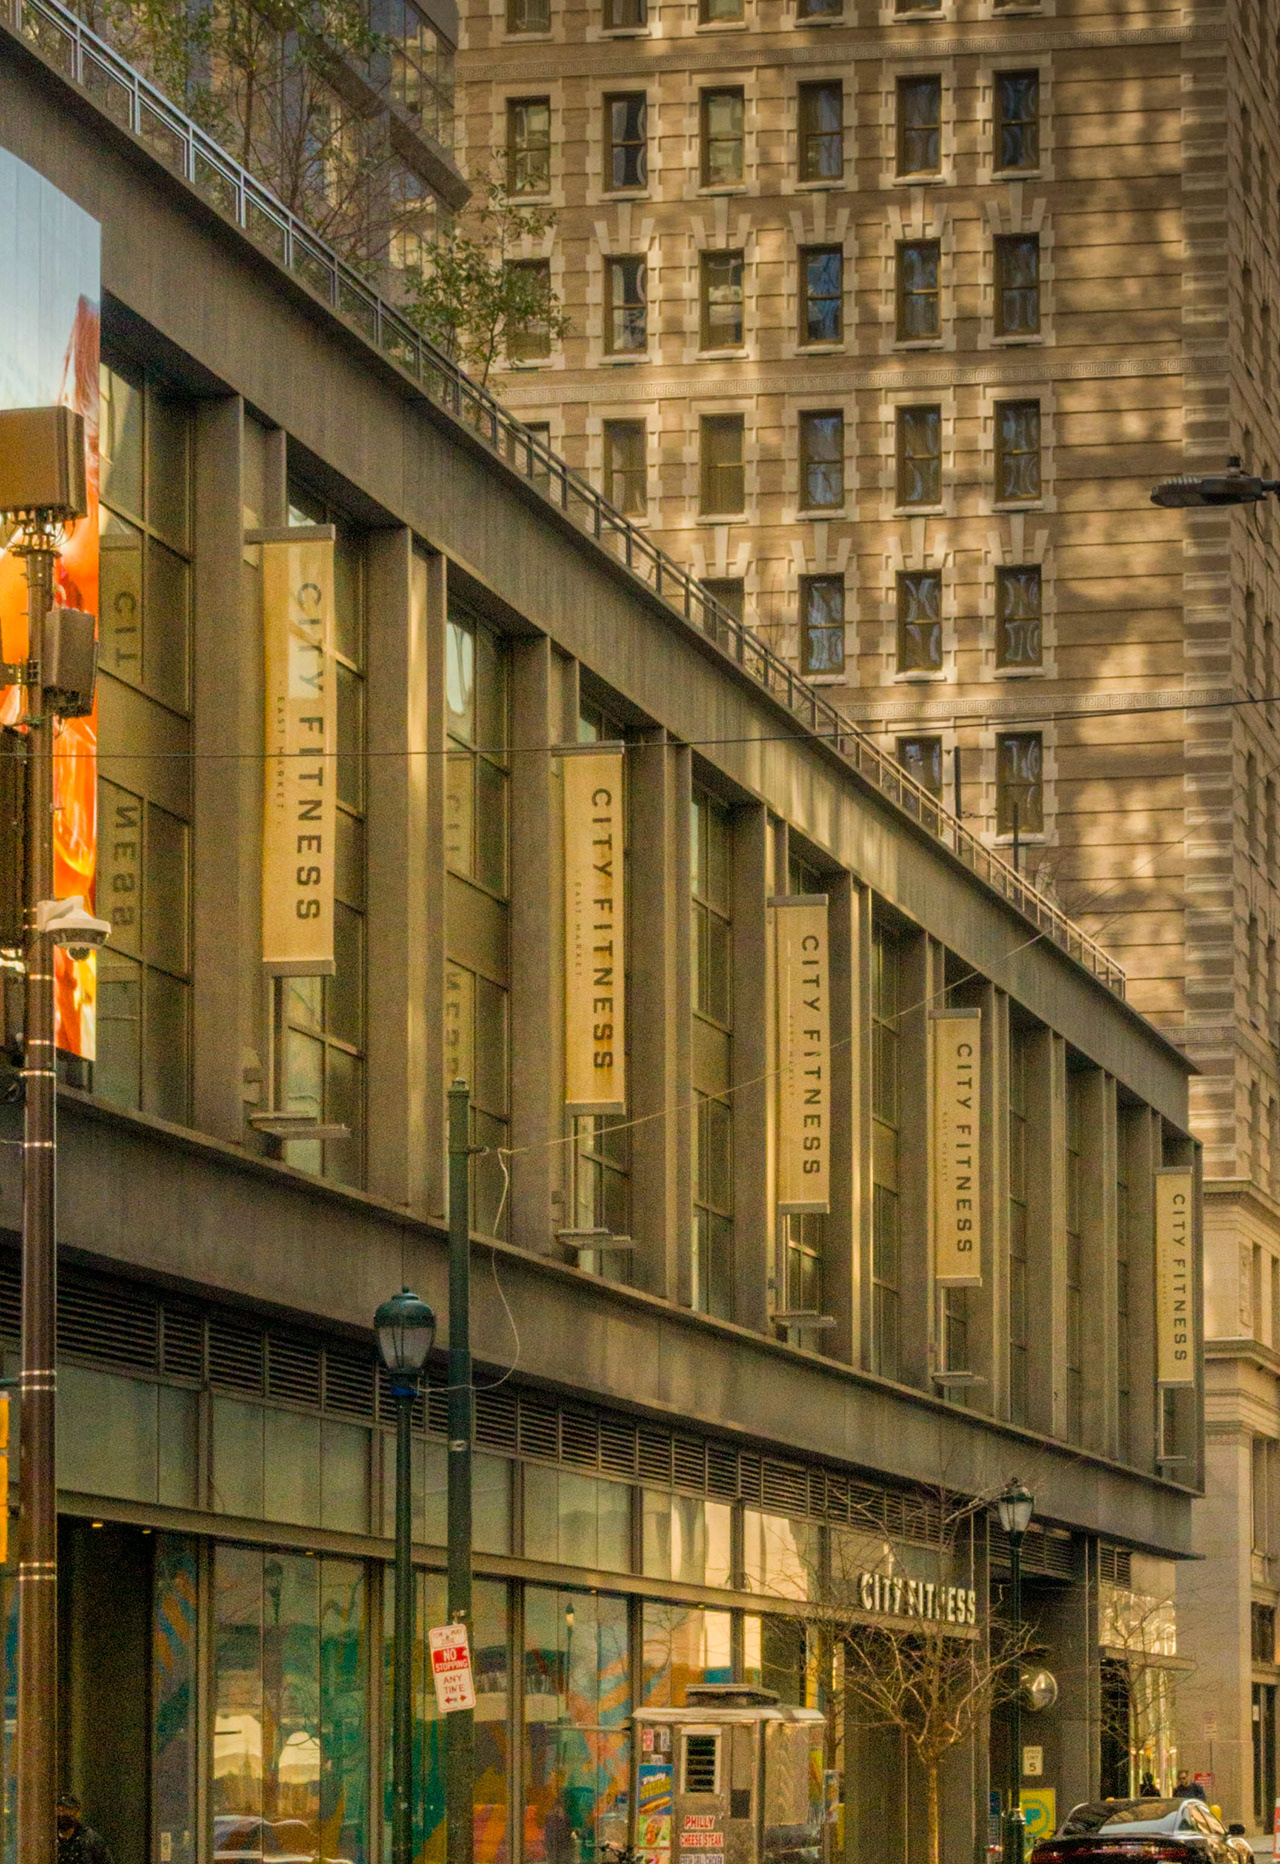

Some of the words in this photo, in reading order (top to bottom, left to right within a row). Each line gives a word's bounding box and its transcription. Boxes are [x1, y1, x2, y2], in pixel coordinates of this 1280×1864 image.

[297, 582, 323, 692] CITY
[277, 695, 285, 736] EAST
[276, 746, 285, 810] MARKET
[296, 715, 324, 920] FITNESS
[591, 787, 613, 878] CITY
[592, 897, 614, 1070] FITNESS
[802, 935, 821, 1012] CITY
[802, 1029, 822, 1176] FITNESS
[956, 1042, 973, 1110] CITY
[956, 1124, 973, 1254] FITNESS
[1172, 1193, 1185, 1248] CITY
[1173, 1258, 1187, 1362] FITNESS
[860, 1572, 903, 1615] CITY
[435, 1658, 468, 1673] STOPPING
[443, 1648, 457, 1662] NO
[443, 1674, 462, 1685] ANY
[444, 1684, 465, 1695] TIME
[1029, 1762, 1037, 1772] 5
[680, 1833, 703, 1847] CHEESE
[704, 1833, 723, 1847] STEAK
[684, 1815, 715, 1829] PHILLY
[1025, 1808, 1041, 1827] P
